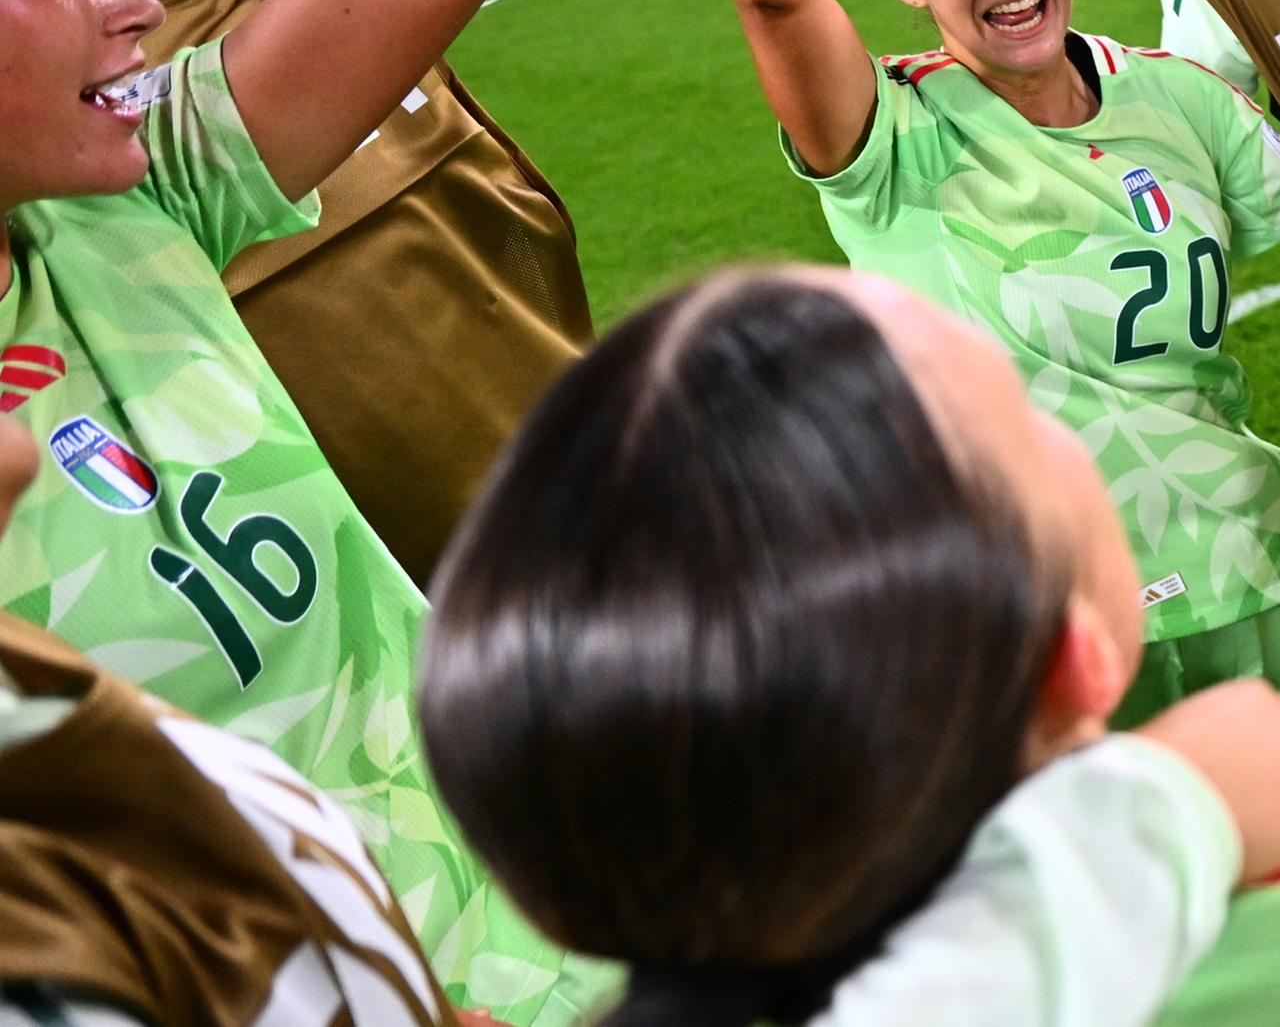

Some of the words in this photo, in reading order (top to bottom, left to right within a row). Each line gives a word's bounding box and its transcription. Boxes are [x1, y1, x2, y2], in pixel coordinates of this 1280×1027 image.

[1124, 170, 1154, 193] ITALIA
[1109, 236, 1230, 367] 20
[52, 422, 102, 464] ITALIA
[148, 470, 319, 693] 16
